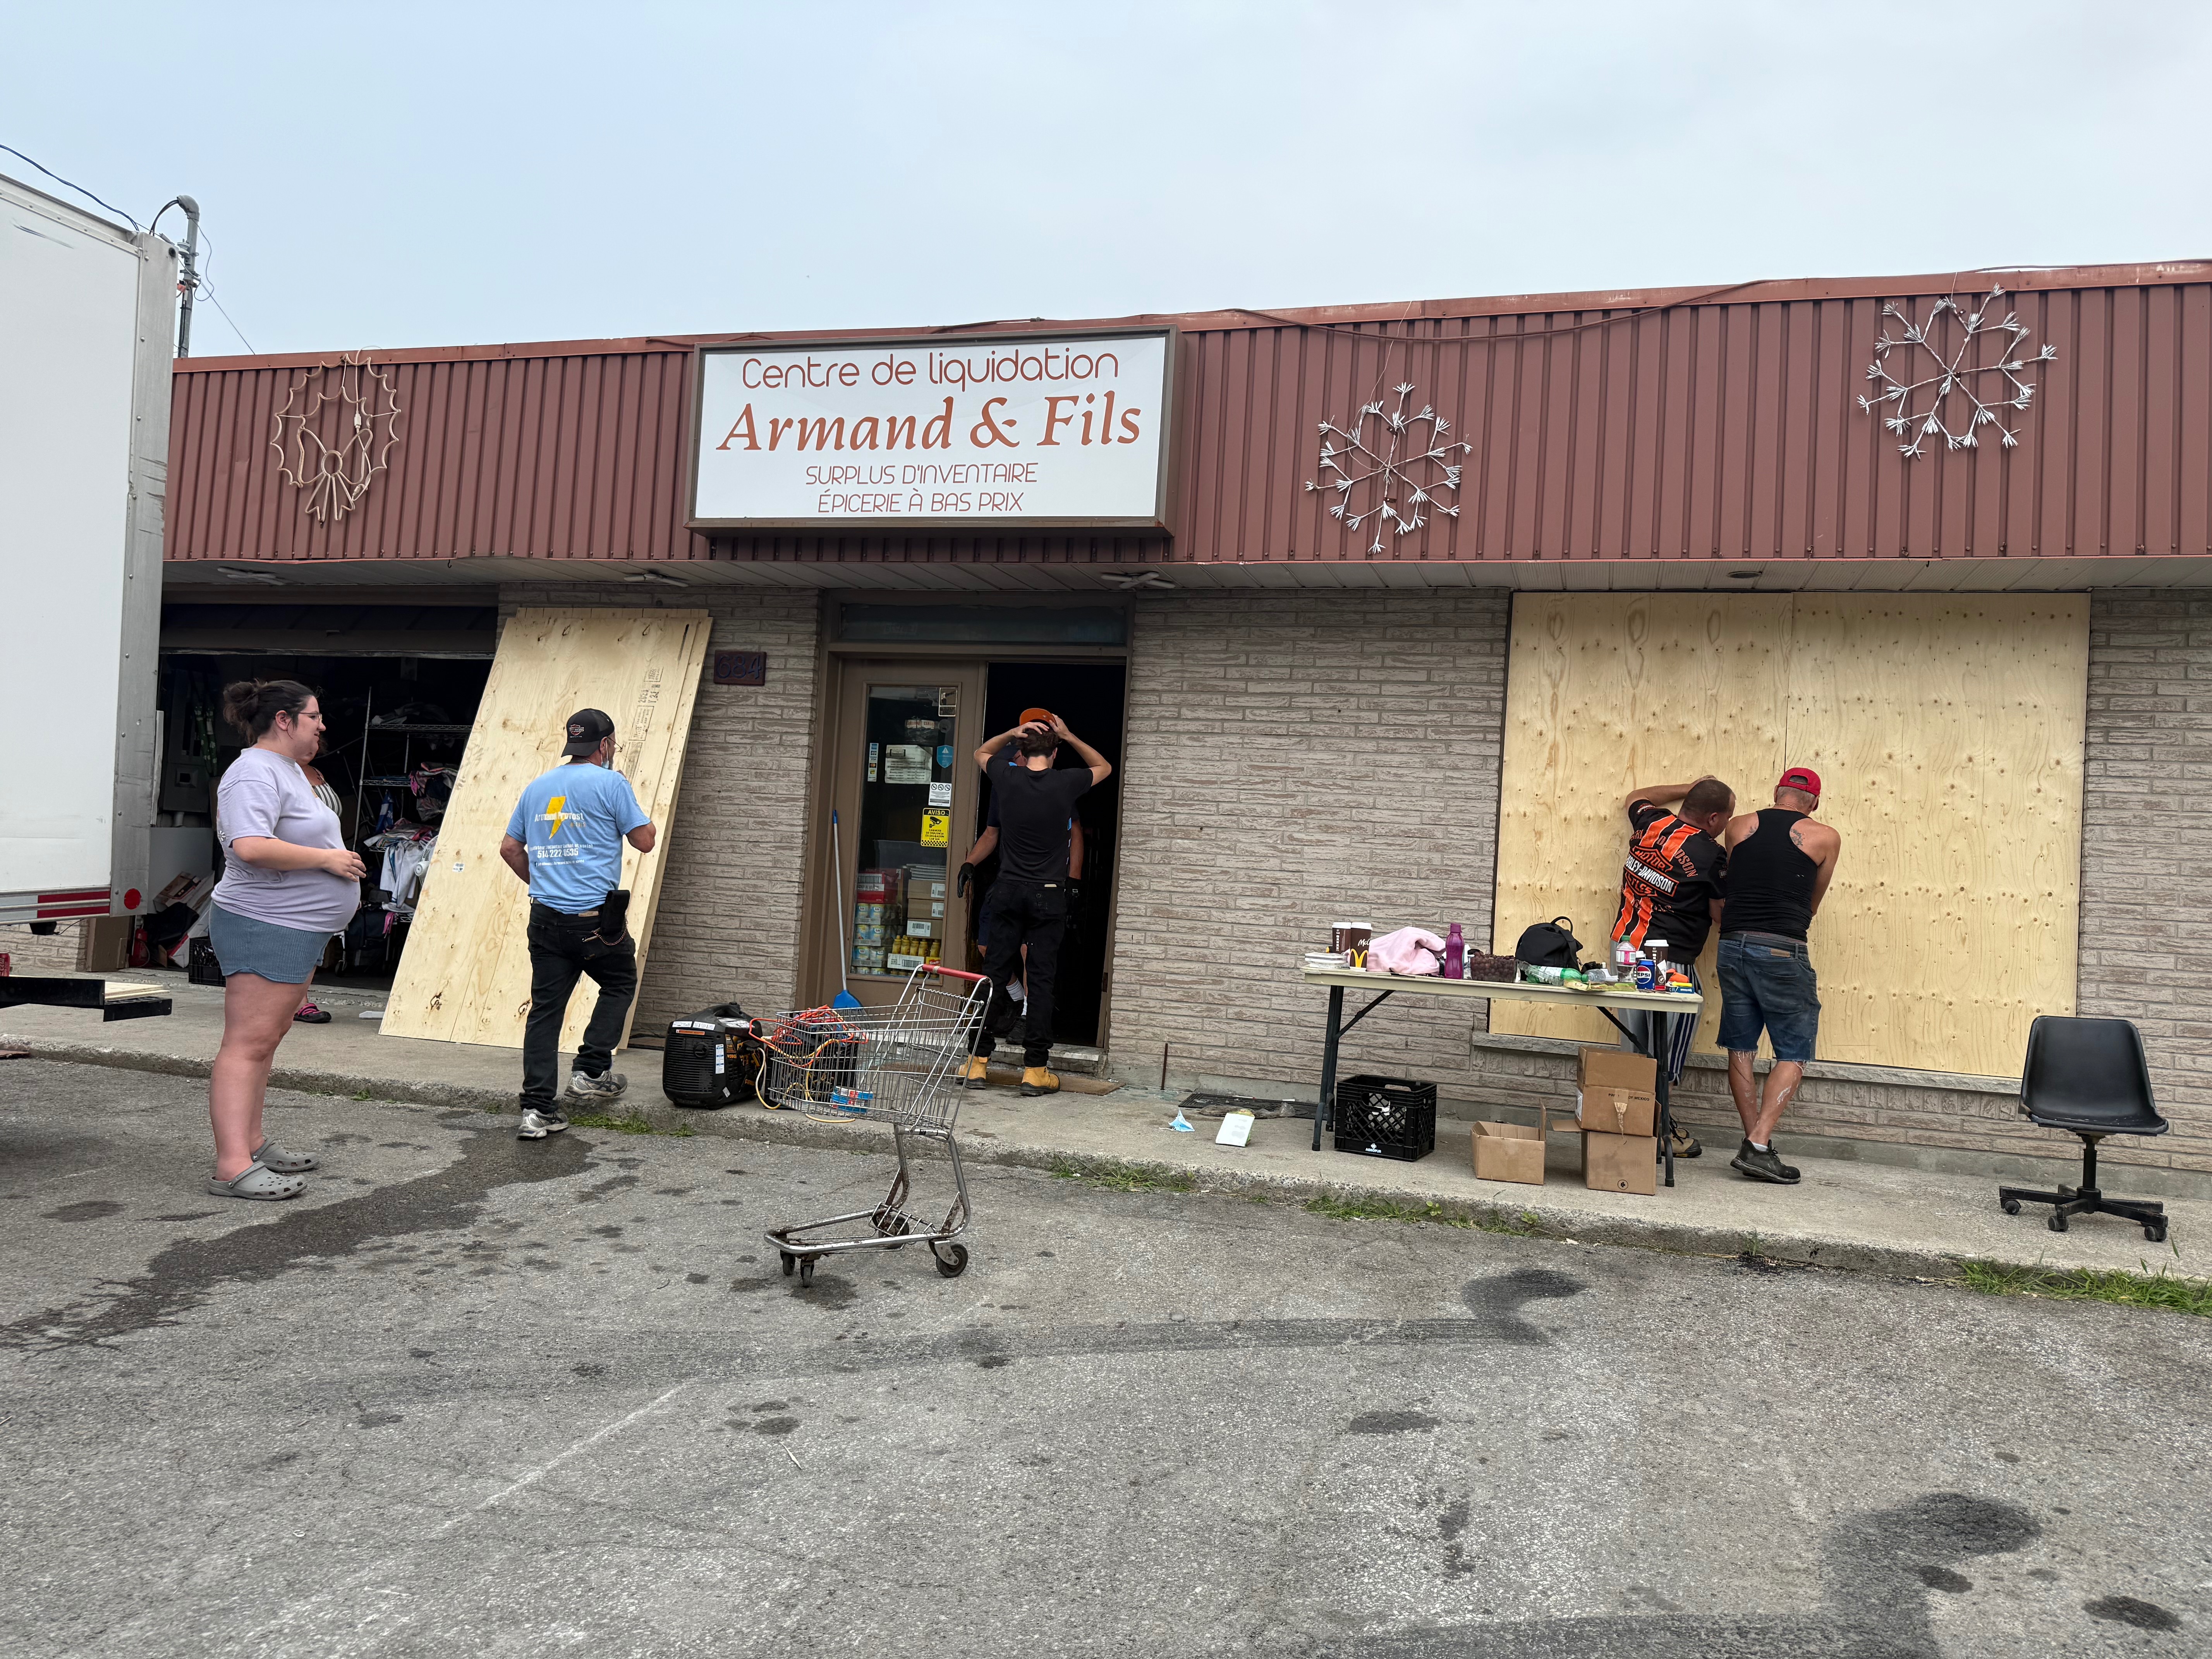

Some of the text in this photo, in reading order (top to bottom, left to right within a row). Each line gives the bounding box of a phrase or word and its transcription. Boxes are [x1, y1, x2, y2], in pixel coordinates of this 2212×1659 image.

[742, 347, 1118, 392] Centre de liquidation
[715, 390, 1141, 451] Armand & Fils
[805, 462, 1039, 485] SURPLUS D'INVENTAIRE
[817, 488, 1024, 513] ÉPICERIE À BAS PRIX
[716, 654, 762, 679] 684
[535, 812, 584, 822] Armand Provost
[1625, 854, 1674, 893] ARLEY-DAVIDSON
